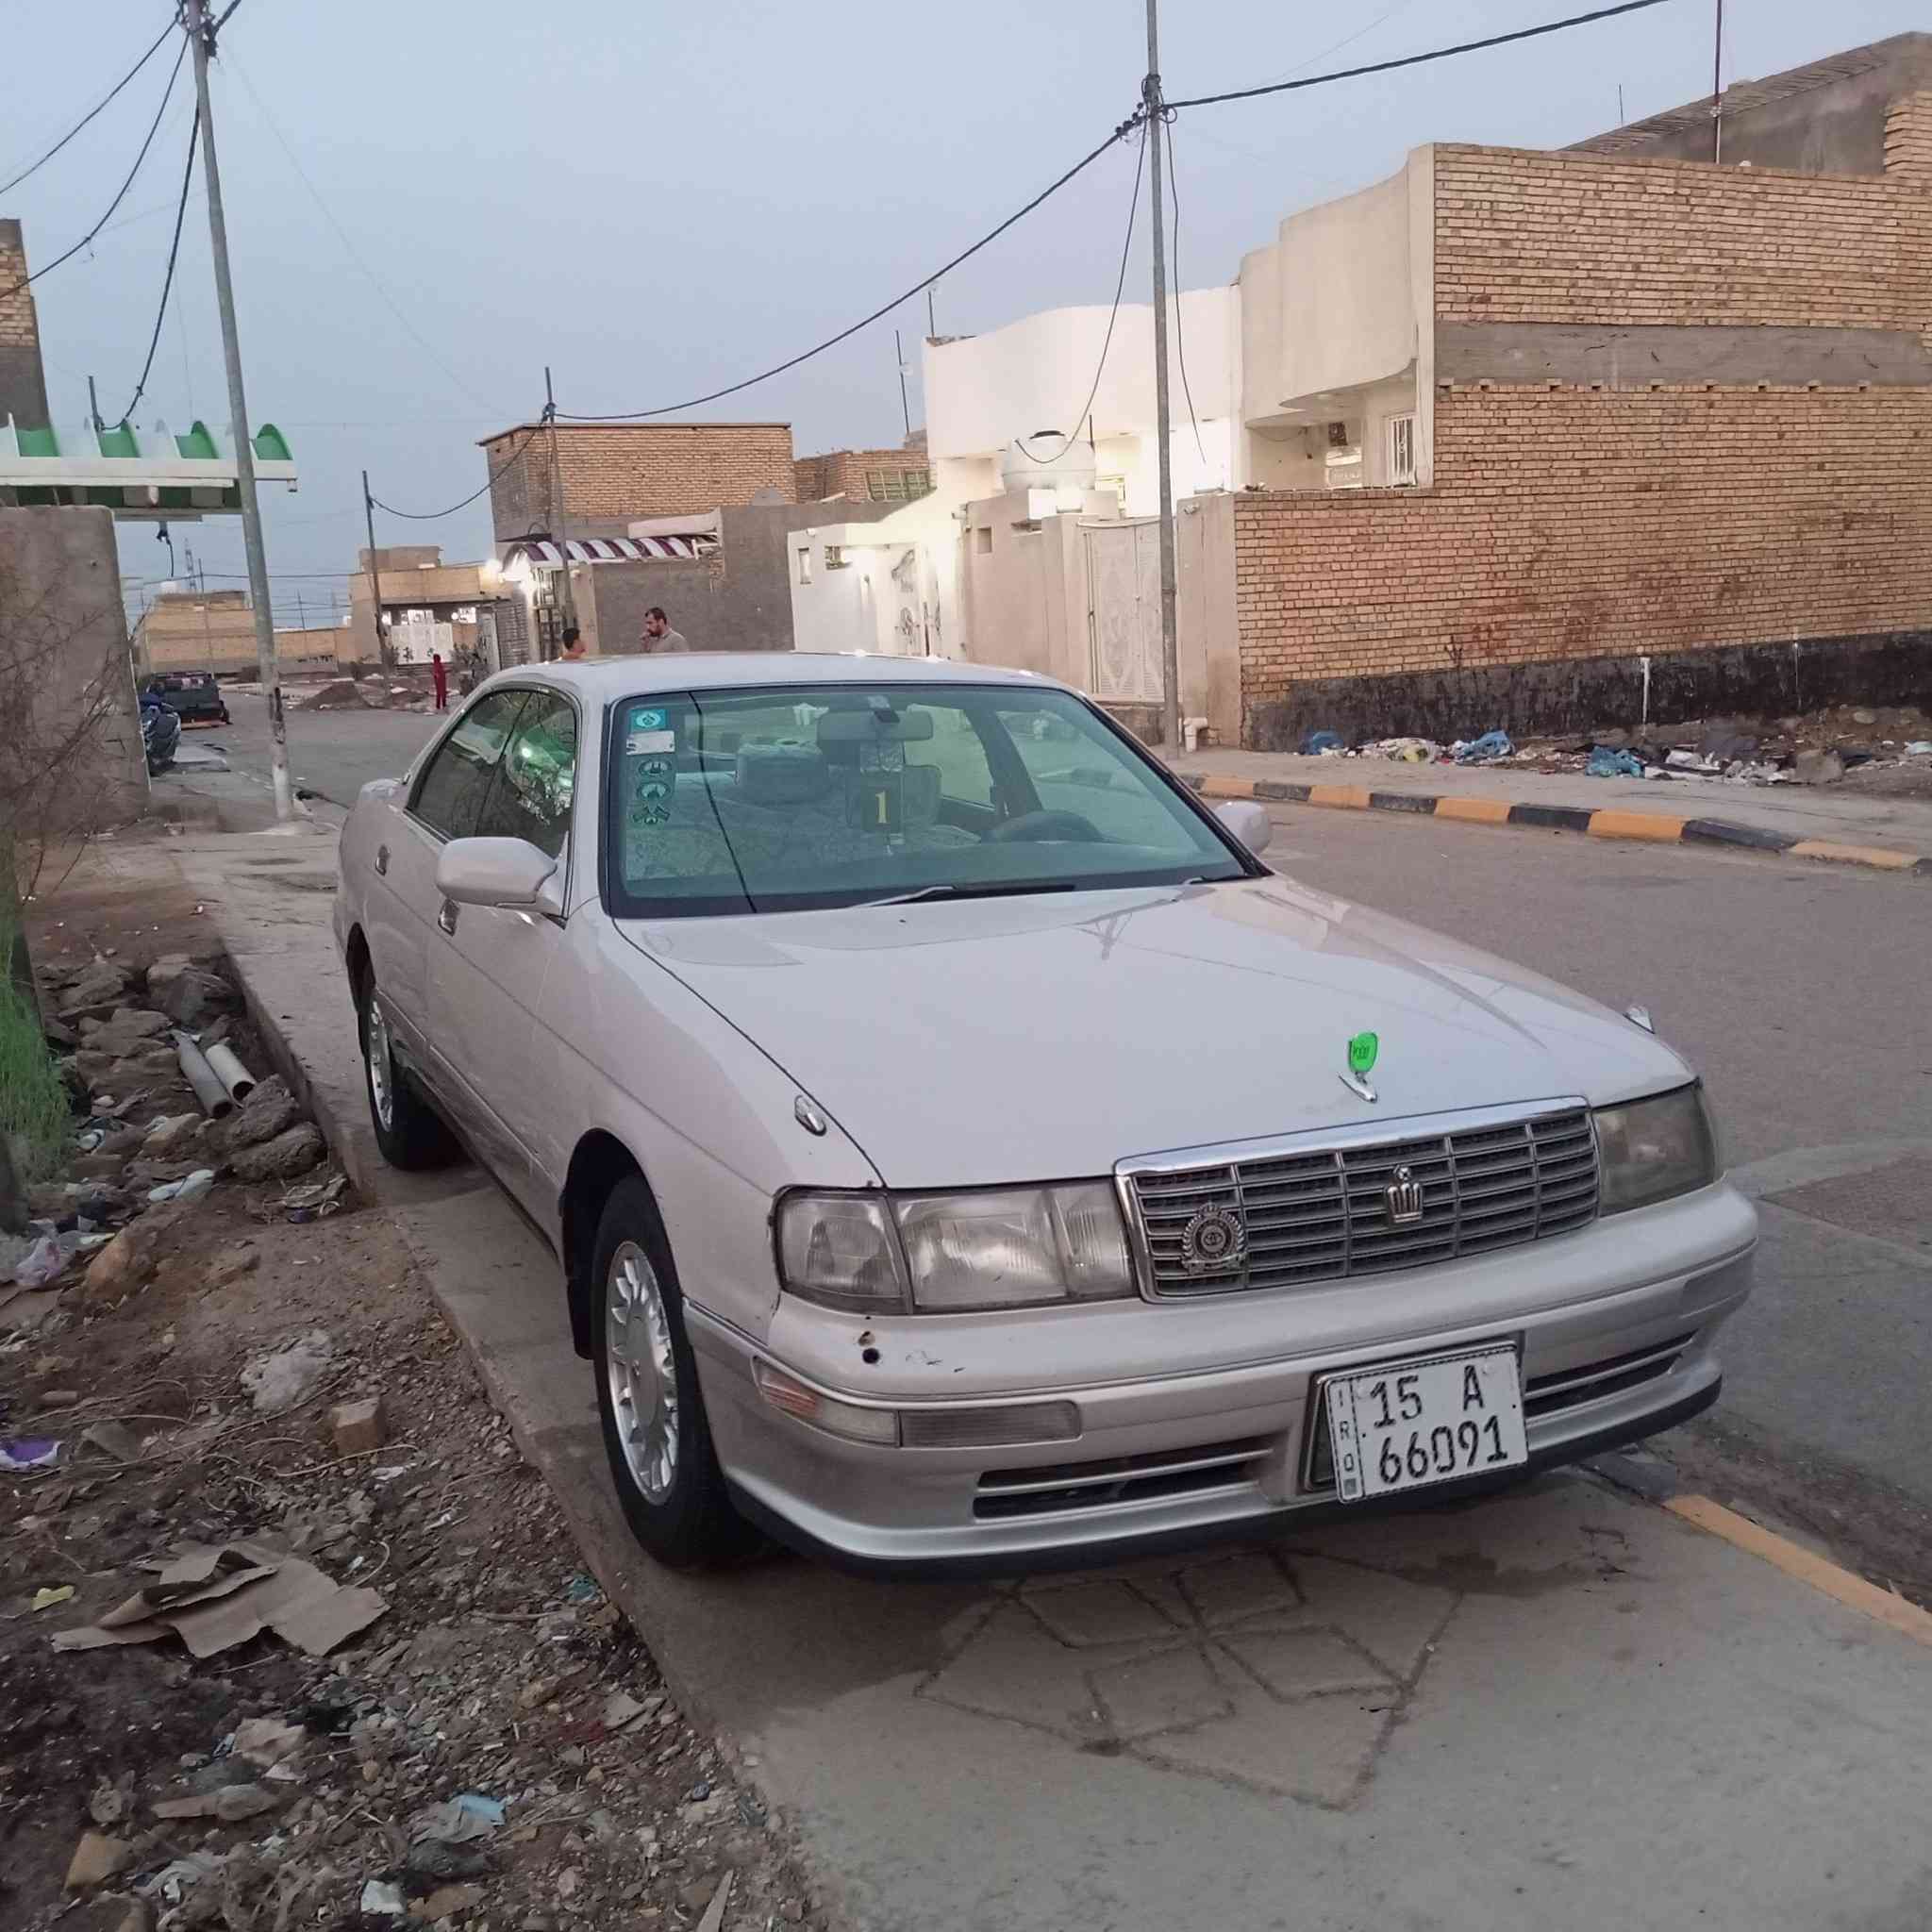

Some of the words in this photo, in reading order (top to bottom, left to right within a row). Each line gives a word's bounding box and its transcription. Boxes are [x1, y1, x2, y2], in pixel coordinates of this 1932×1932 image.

[875, 791, 888, 824] 1
[1370, 1374, 1423, 1427] 15
[1463, 1365, 1484, 1412] A
[1380, 1415, 1508, 1484] 66091
